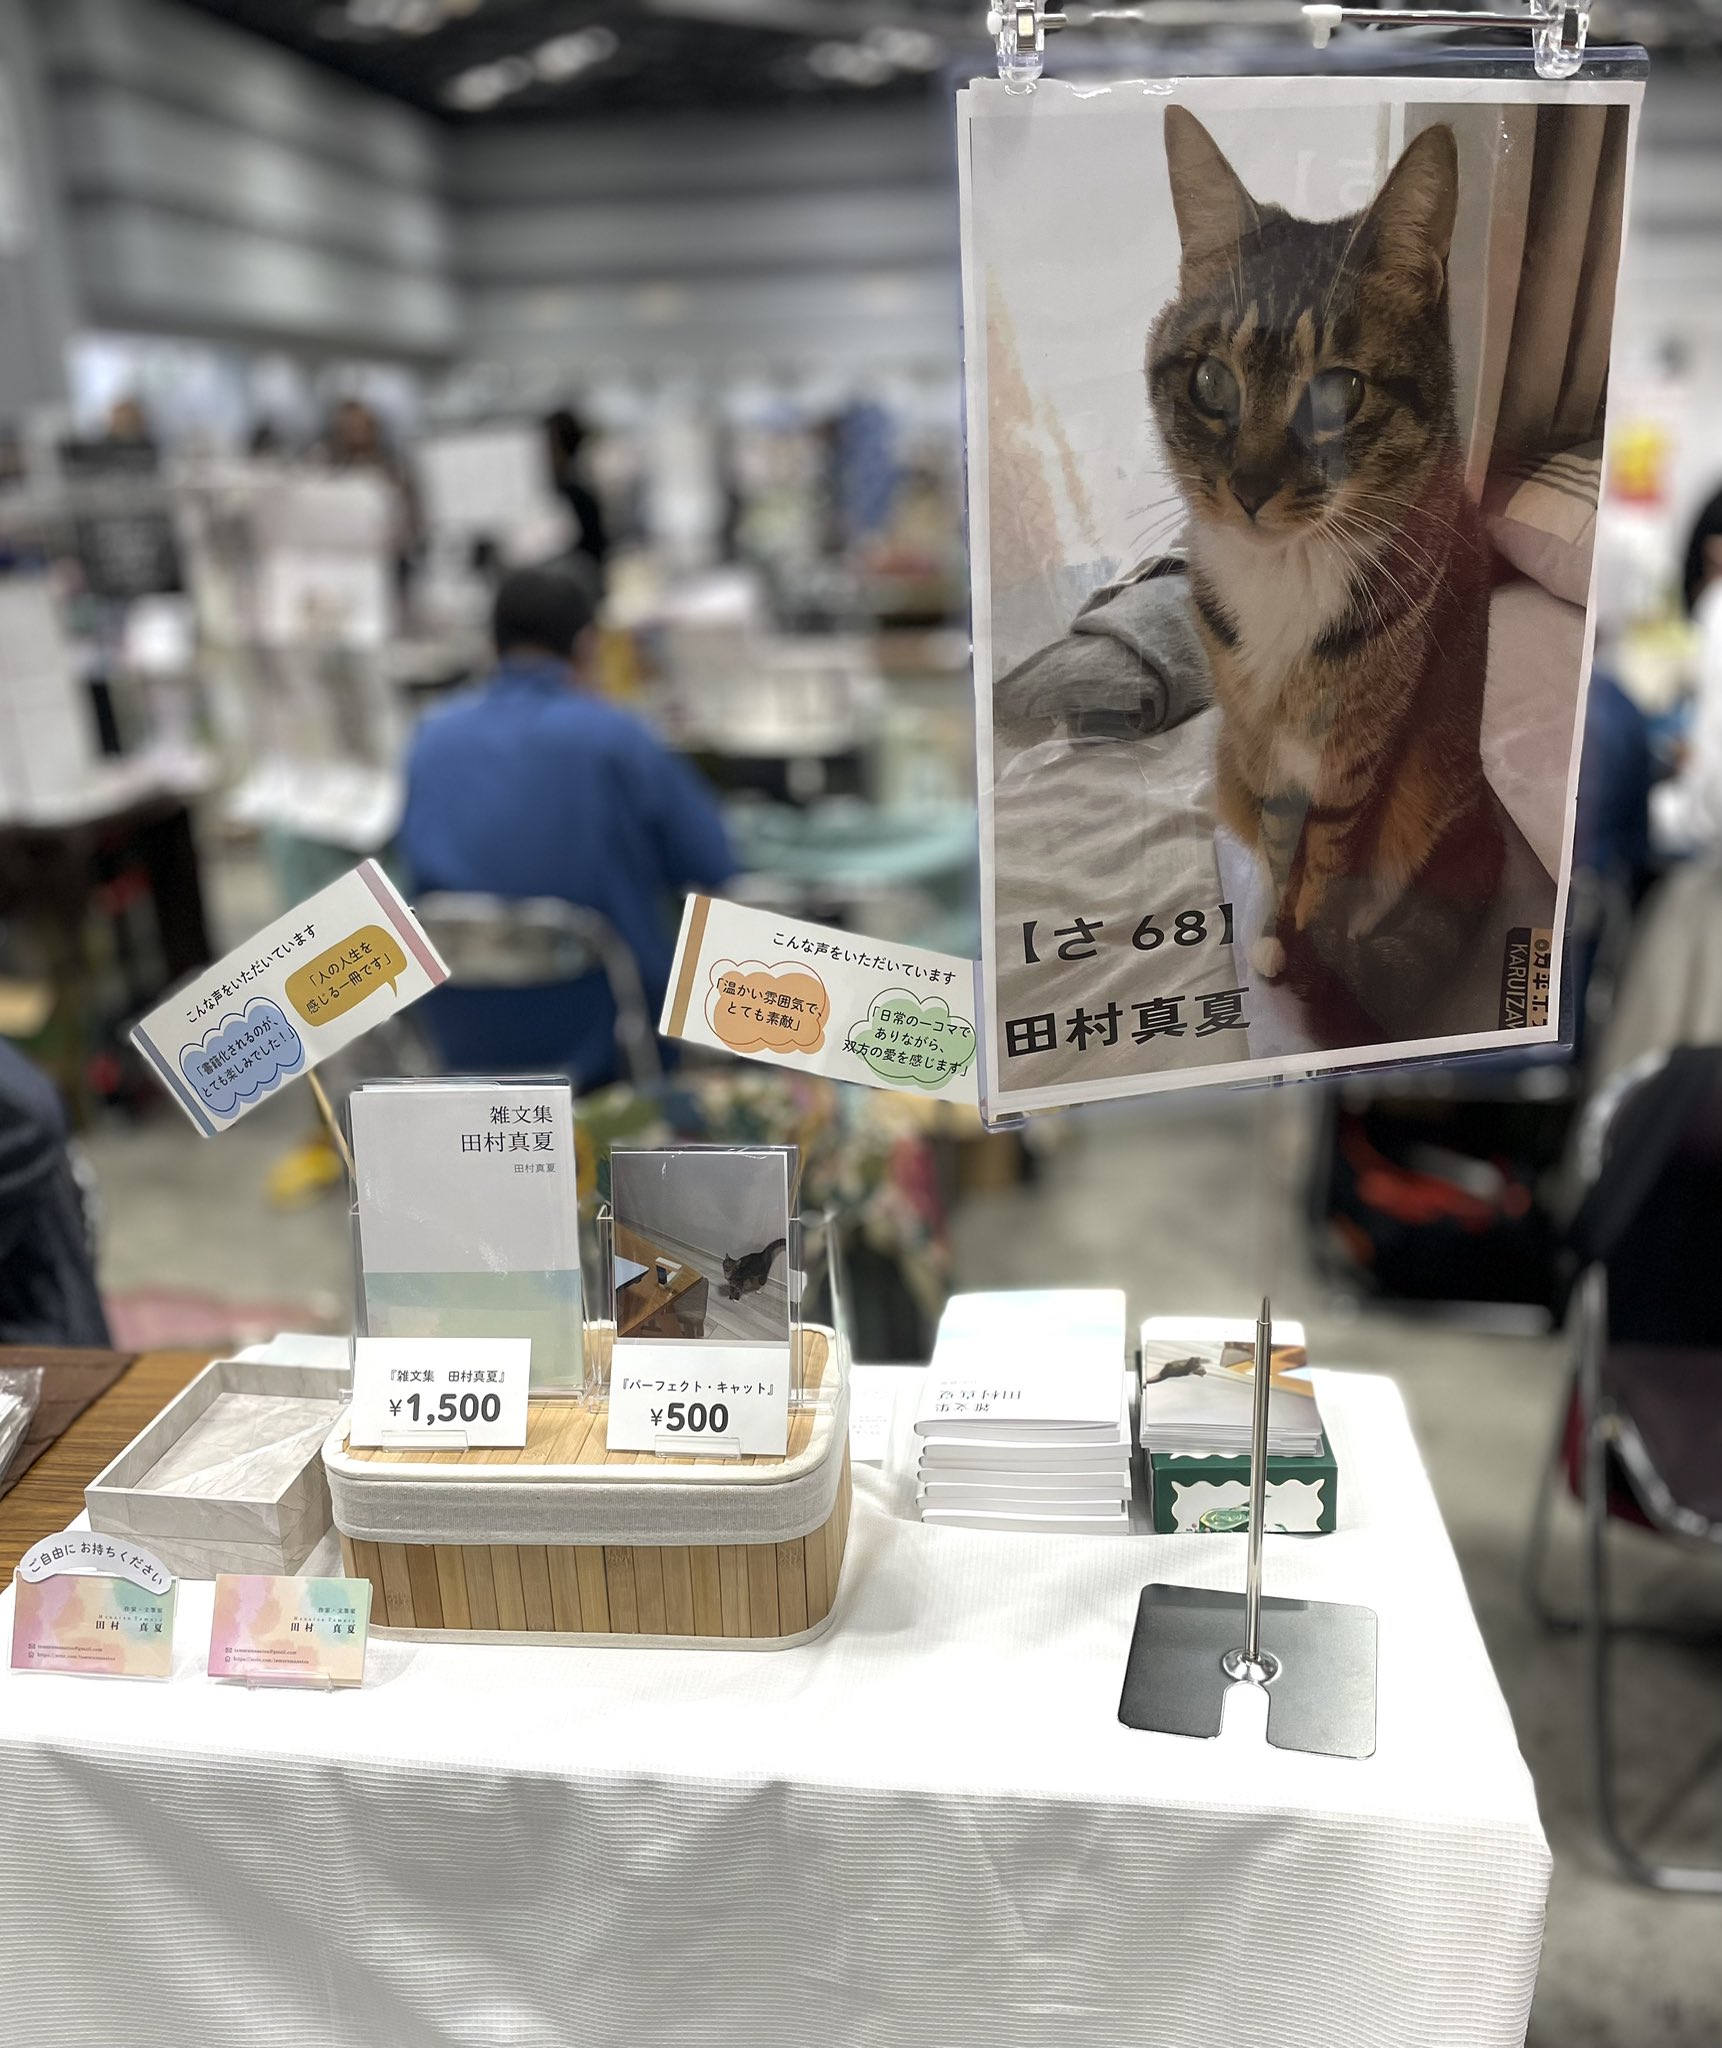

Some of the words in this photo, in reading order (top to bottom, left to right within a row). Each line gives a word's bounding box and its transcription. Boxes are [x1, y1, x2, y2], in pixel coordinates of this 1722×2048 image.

[186, 923, 317, 1023] こんな声をいただいています
[309, 941, 373, 988] 「人の人生を
[772, 932, 956, 986] こんな声をいただいています
[306, 953, 392, 1015] 感じる一冊です」
[716, 977, 822, 1018] 「温かい雰囲気で、
[727, 1001, 801, 1032] とても素敵」
[872, 1006, 971, 1039] 「日常の一コマで
[1005, 987, 1251, 1058] 田村真夏
[197, 1016, 278, 1077] 「書籍化されるのが、
[874, 1027, 944, 1053] ありながら、
[842, 1039, 968, 1077] 双方の愛を感じます」
[490, 1105, 553, 1125] 雑文集
[461, 1131, 555, 1153] 田村真夏
[514, 1163, 556, 1174] 田村真夏
[622, 1378, 774, 1396] 『パーフェクト・キャット』
[389, 1393, 501, 1426] ¥1,500
[650, 1402, 729, 1433] ¥500
